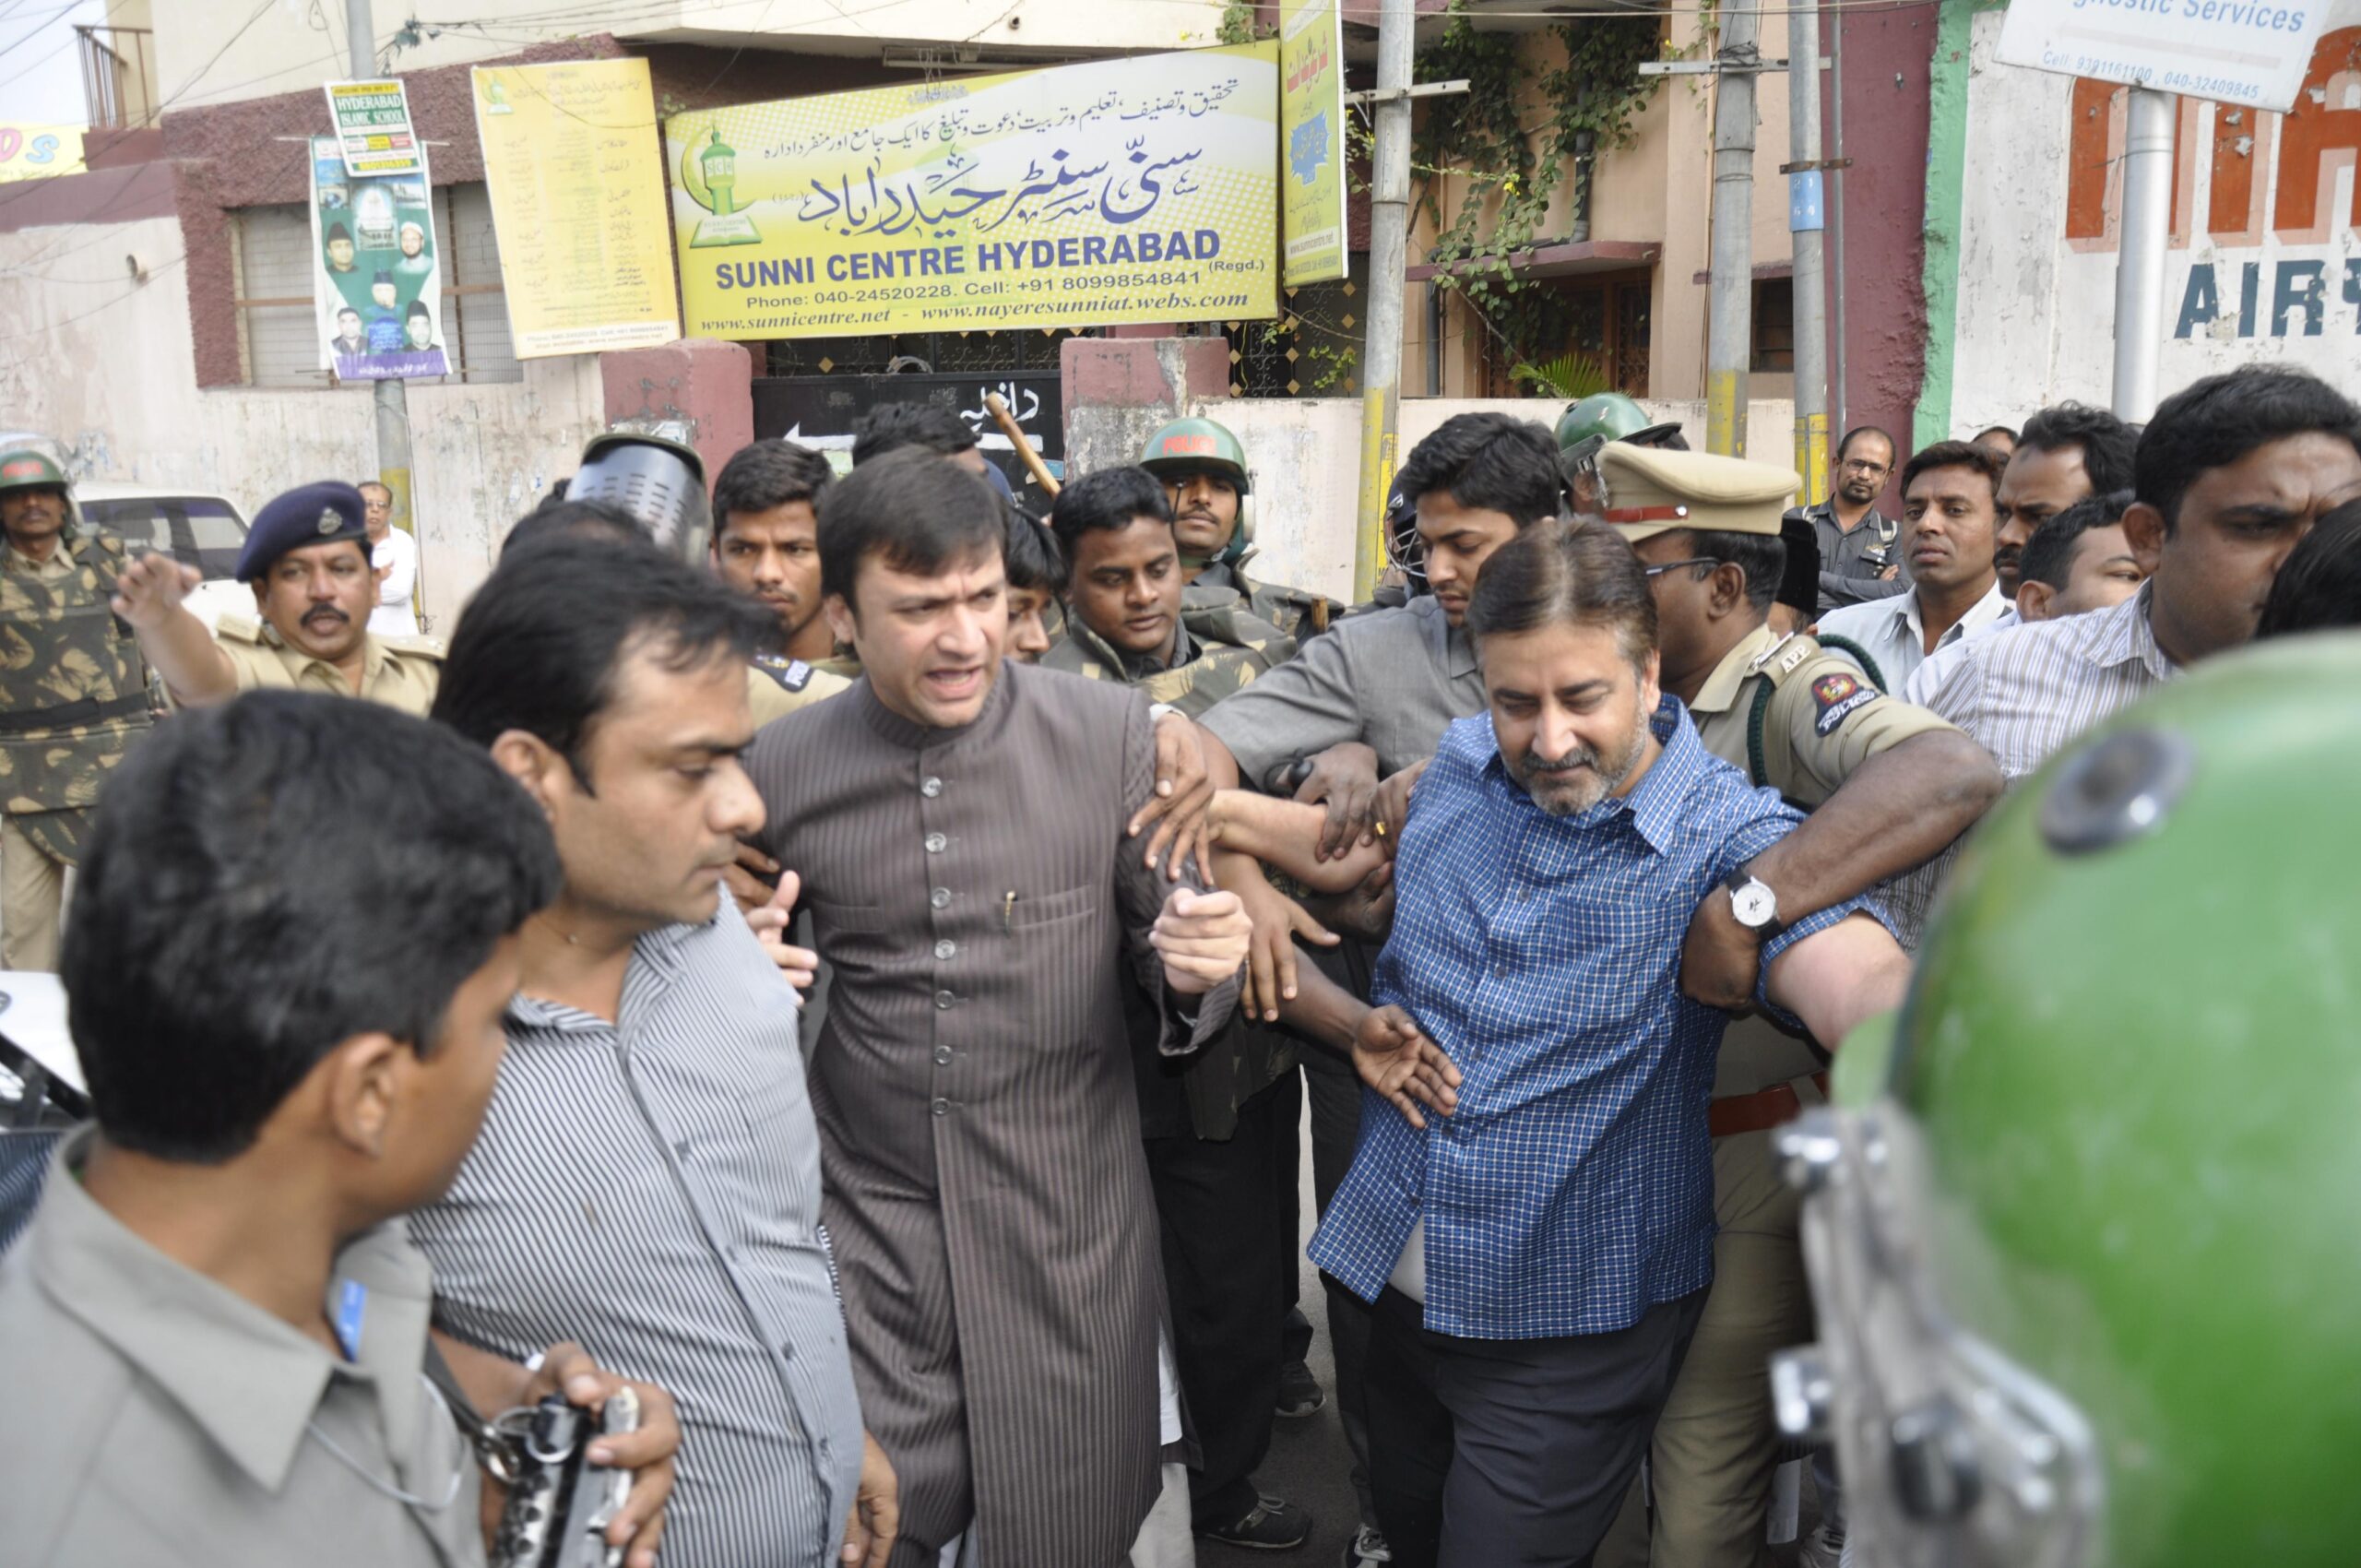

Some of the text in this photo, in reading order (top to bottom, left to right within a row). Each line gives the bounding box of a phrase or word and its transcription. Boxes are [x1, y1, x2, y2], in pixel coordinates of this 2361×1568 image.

[2183, 2, 2305, 33] Services
[2043, 51, 2072, 68] Cell:
[2163, 71, 2260, 100] 040-32409845
[337, 93, 402, 112] HYDERABAD
[373, 110, 406, 125] SCHOOL
[715, 229, 1221, 291] SUNNI CENTRE HYDERABAD
[1207, 259, 1266, 274] (Regd.)
[746, 270, 1202, 310] Phone: 040-24520228. Cell: +91 8099854841
[700, 308, 892, 331] www.sunnicentre.net
[921, 291, 1250, 320] www.nayeresunniat.webs.com
